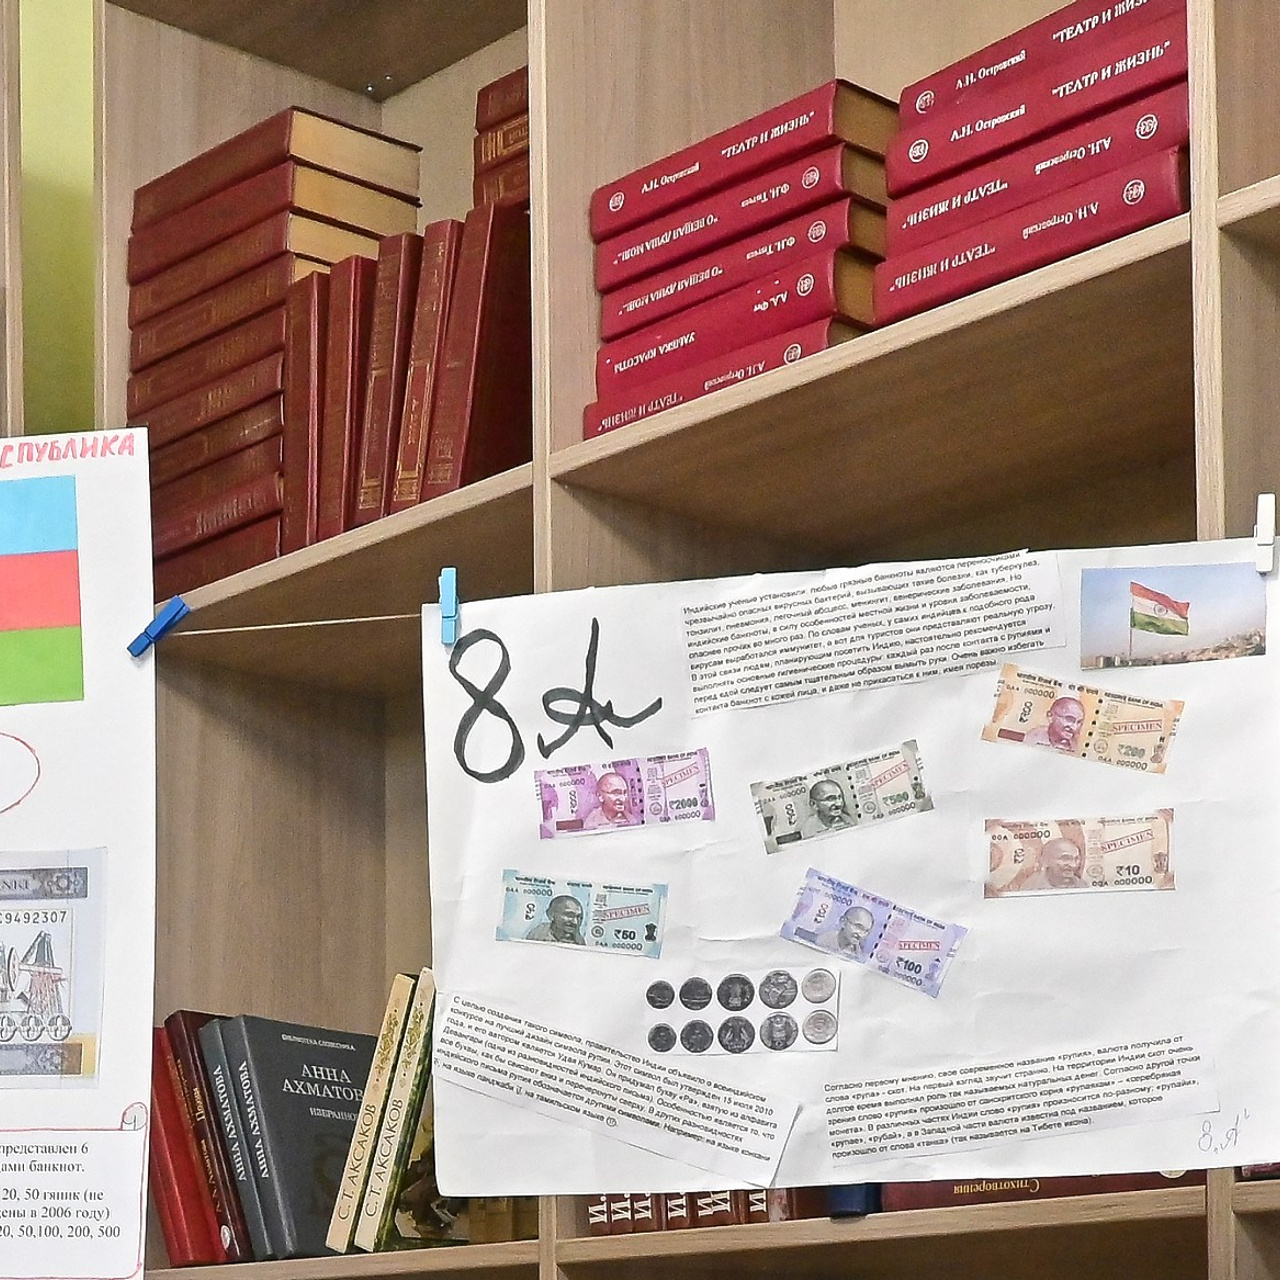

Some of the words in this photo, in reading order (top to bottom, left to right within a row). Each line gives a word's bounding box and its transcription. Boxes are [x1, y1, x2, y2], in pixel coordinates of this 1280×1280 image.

[1101, 65, 1112, 80] И
[950, 124, 973, 142] А.Н.
[975, 104, 1026, 132] Островский
[449, 625, 523, 784] 8
[1113, 720, 1163, 732] SPECIMEN
[1101, 831, 1154, 850] SPECIMEN
[1116, 865, 1140, 876] ₹10
[300, 1063, 352, 1084] АННА
[212, 1064, 238, 1140] АХМАТОВА
[81, 1142, 89, 1154] 6
[348, 1103, 376, 1186] АКСАКОВ
[29, 1160, 85, 1173] банкнот.
[231, 1144, 247, 1182] АННА
[341, 1186, 354, 1200] Т.
[953, 1177, 1040, 1195] Стихотворения
[24, 1188, 39, 1201] 50
[43, 1190, 80, 1201] гяпик
[84, 1188, 104, 1202] (не
[30, 1209, 37, 1219] в
[41, 1207, 71, 1219] 2006
[75, 1207, 110, 1221] году)
[337, 1201, 350, 1220] С.
[67, 1226, 93, 1238] 200,
[98, 1225, 120, 1238] 500
